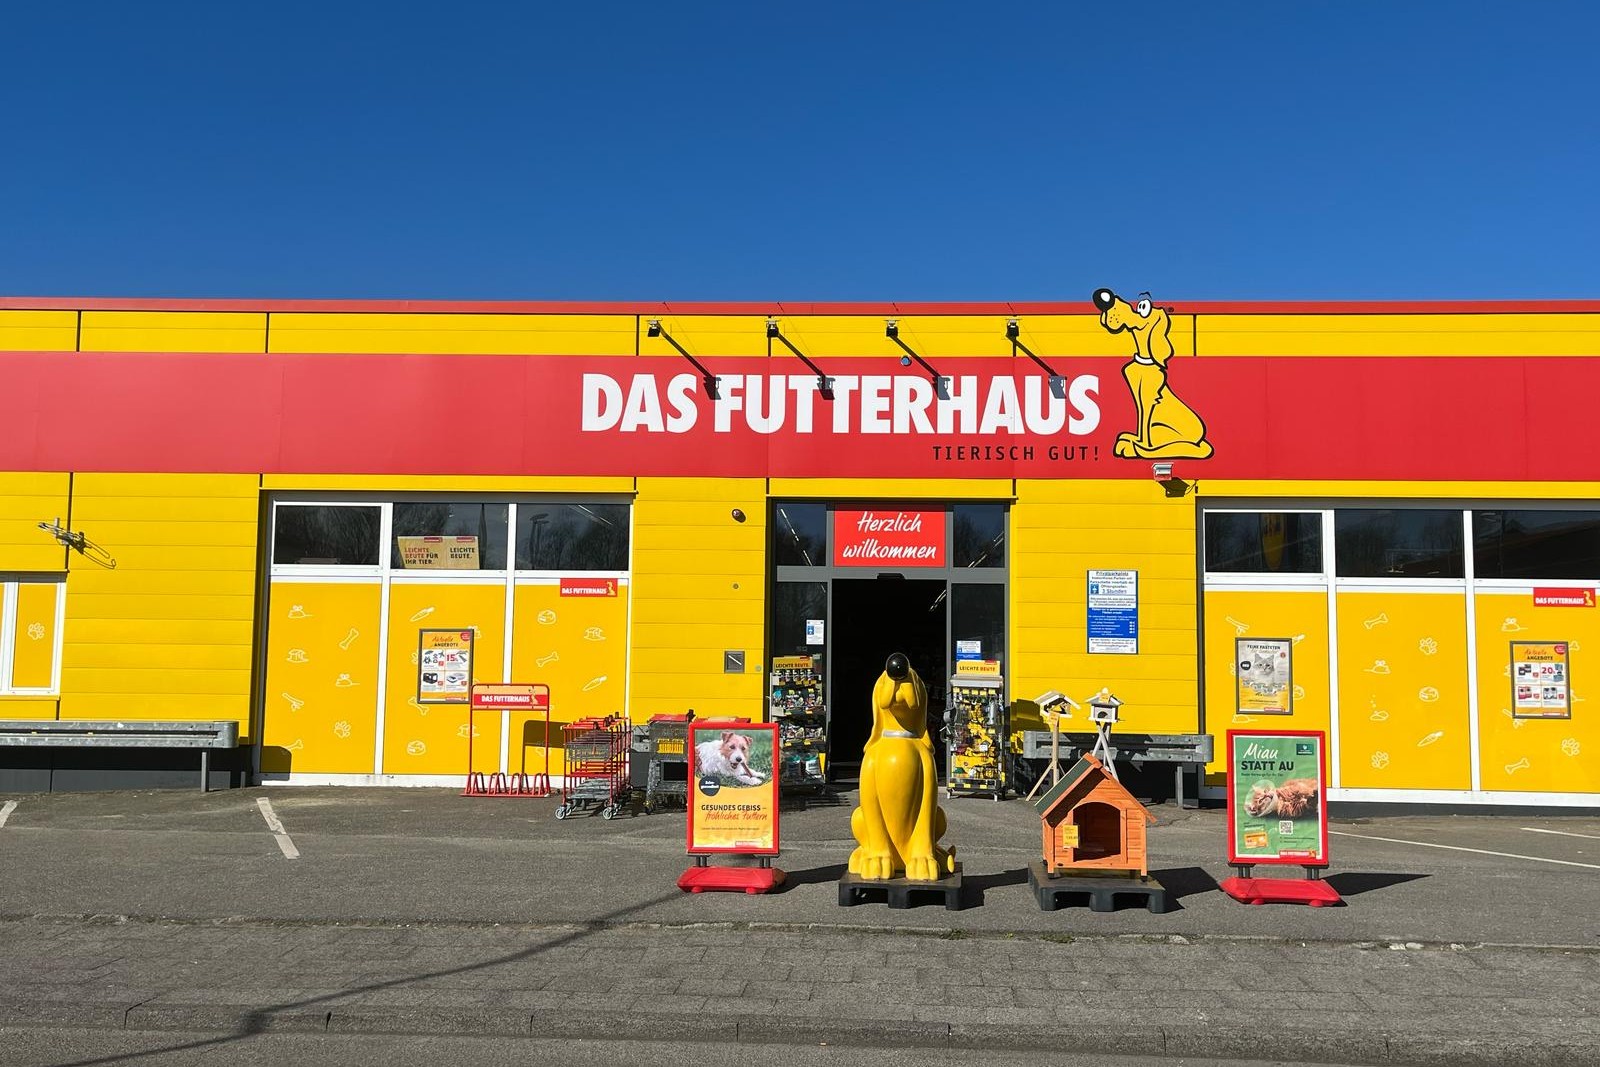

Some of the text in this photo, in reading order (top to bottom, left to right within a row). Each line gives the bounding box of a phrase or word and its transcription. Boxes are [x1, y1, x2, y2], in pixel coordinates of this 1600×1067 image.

[582, 373, 1101, 435] DAS FUTTERHAUS
[933, 446, 1099, 461] TIERISCH GUT!
[857, 511, 922, 533] Herzlich
[842, 538, 936, 559] willkommen
[573, 587, 607, 595] FUTTERHAUS
[1547, 597, 1585, 605] FUTTERHAUS
[493, 695, 530, 703] FUTTERHAUS
[1243, 742, 1279, 760] Miau
[1241, 760, 1294, 771] STATT AU
[737, 804, 761, 812] GEBISS
